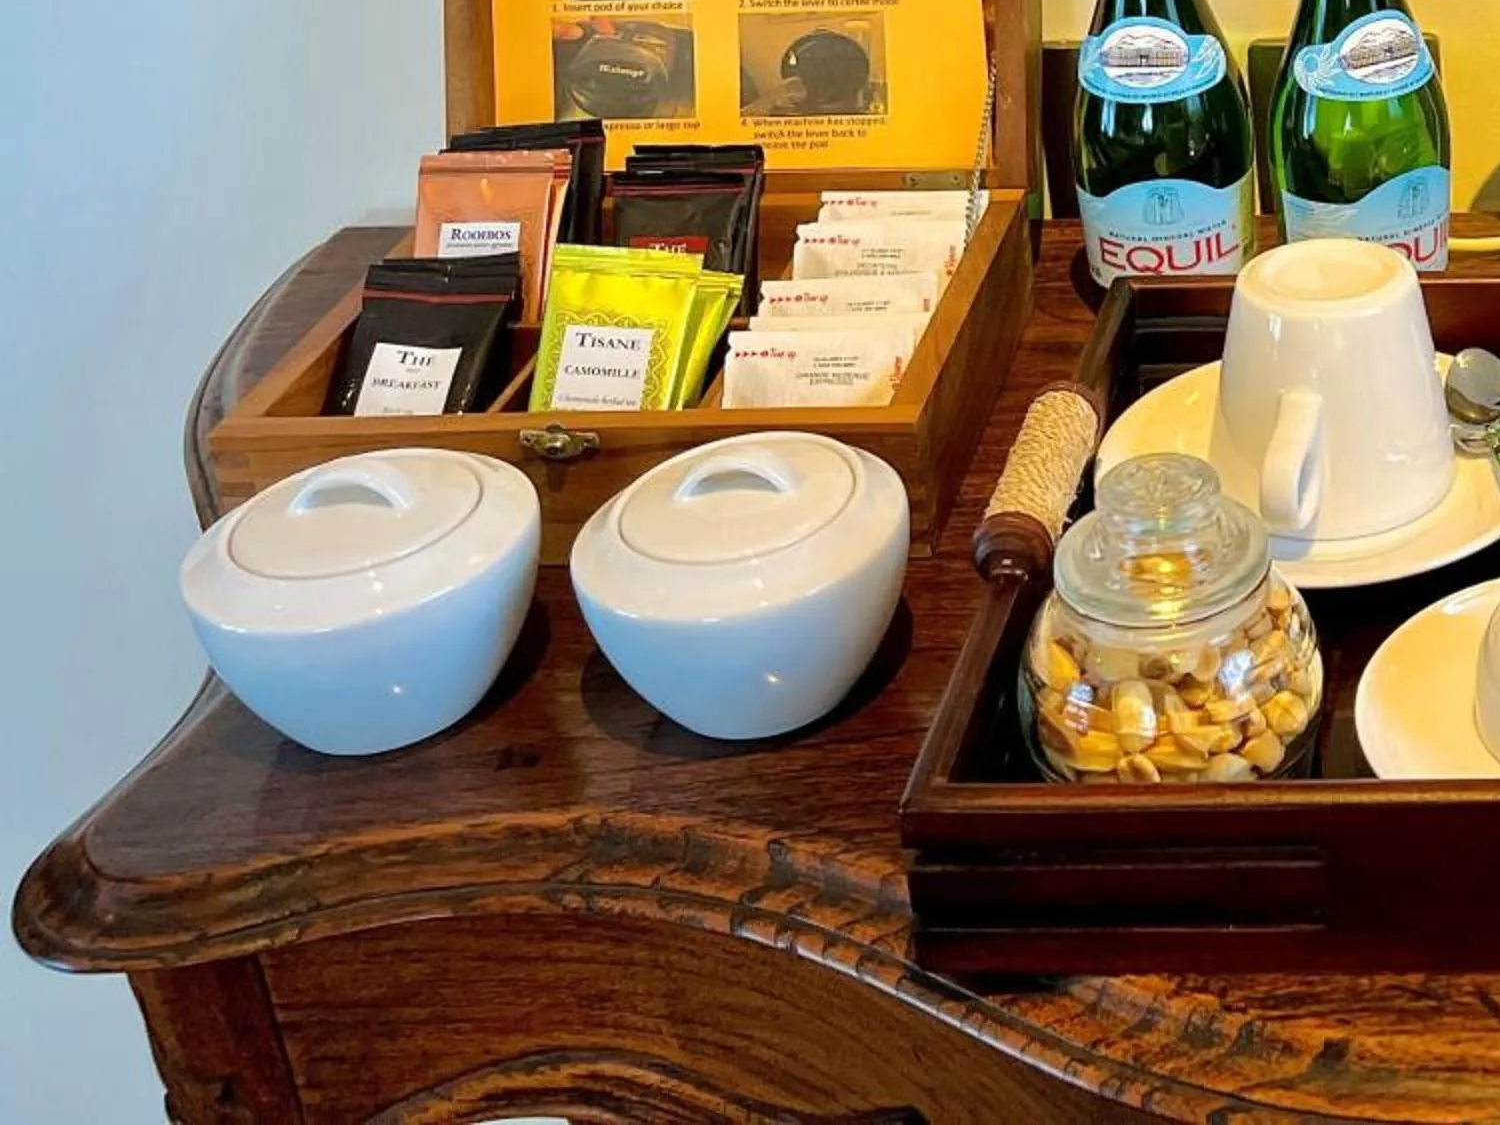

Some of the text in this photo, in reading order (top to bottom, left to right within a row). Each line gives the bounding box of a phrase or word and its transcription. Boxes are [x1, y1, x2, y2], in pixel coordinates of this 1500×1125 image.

[564, 3, 592, 12] Insert
[594, 3, 612, 12] pod
[616, 2, 625, 11] of
[627, 3, 649, 12] your
[651, 2, 682, 11] choice
[1109, 231, 1147, 242] NATURAL
[1099, 232, 1239, 274] EQUIL
[576, 332, 640, 351] TISANE
[564, 364, 640, 378] CAMOMILLE
